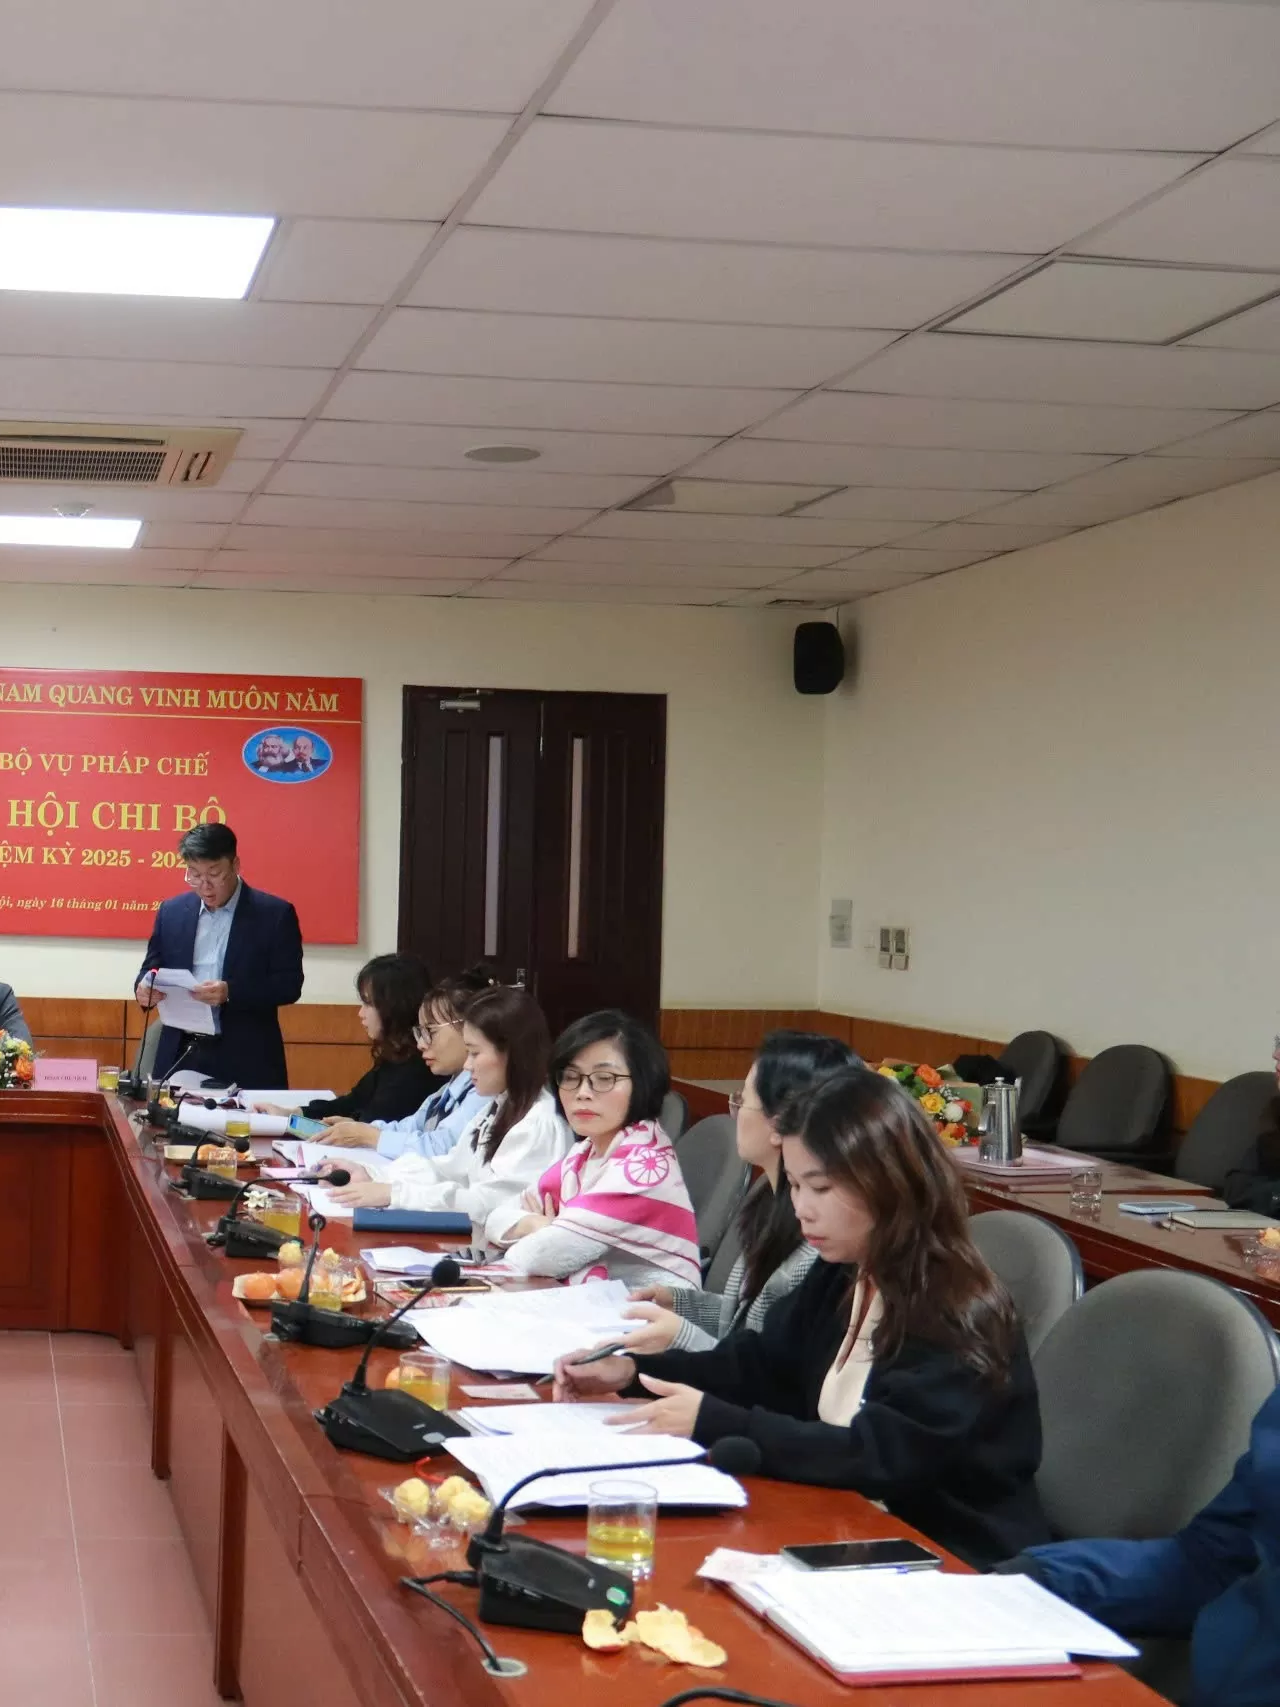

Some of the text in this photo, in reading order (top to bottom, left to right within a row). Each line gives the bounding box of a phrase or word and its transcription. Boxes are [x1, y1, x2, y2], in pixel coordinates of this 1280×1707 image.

[48, 684, 134, 707] QUANG
[139, 687, 201, 708] VINH
[206, 684, 280, 711] MUÔN
[285, 687, 339, 713] NĂM
[39, 753, 73, 777] VỤ
[81, 751, 150, 775] PHÁP
[157, 750, 210, 776] CHẾ
[7, 791, 80, 837] HỘI
[91, 801, 162, 832] CHI
[41, 841, 76, 865] KỲ
[80, 849, 132, 867] 2025
[151, 850, 188, 869] 202
[17, 895, 47, 910] ngày
[50, 897, 64, 909] 16
[67, 897, 102, 911] tháng
[105, 899, 118, 910] 01
[122, 900, 149, 911] năm
